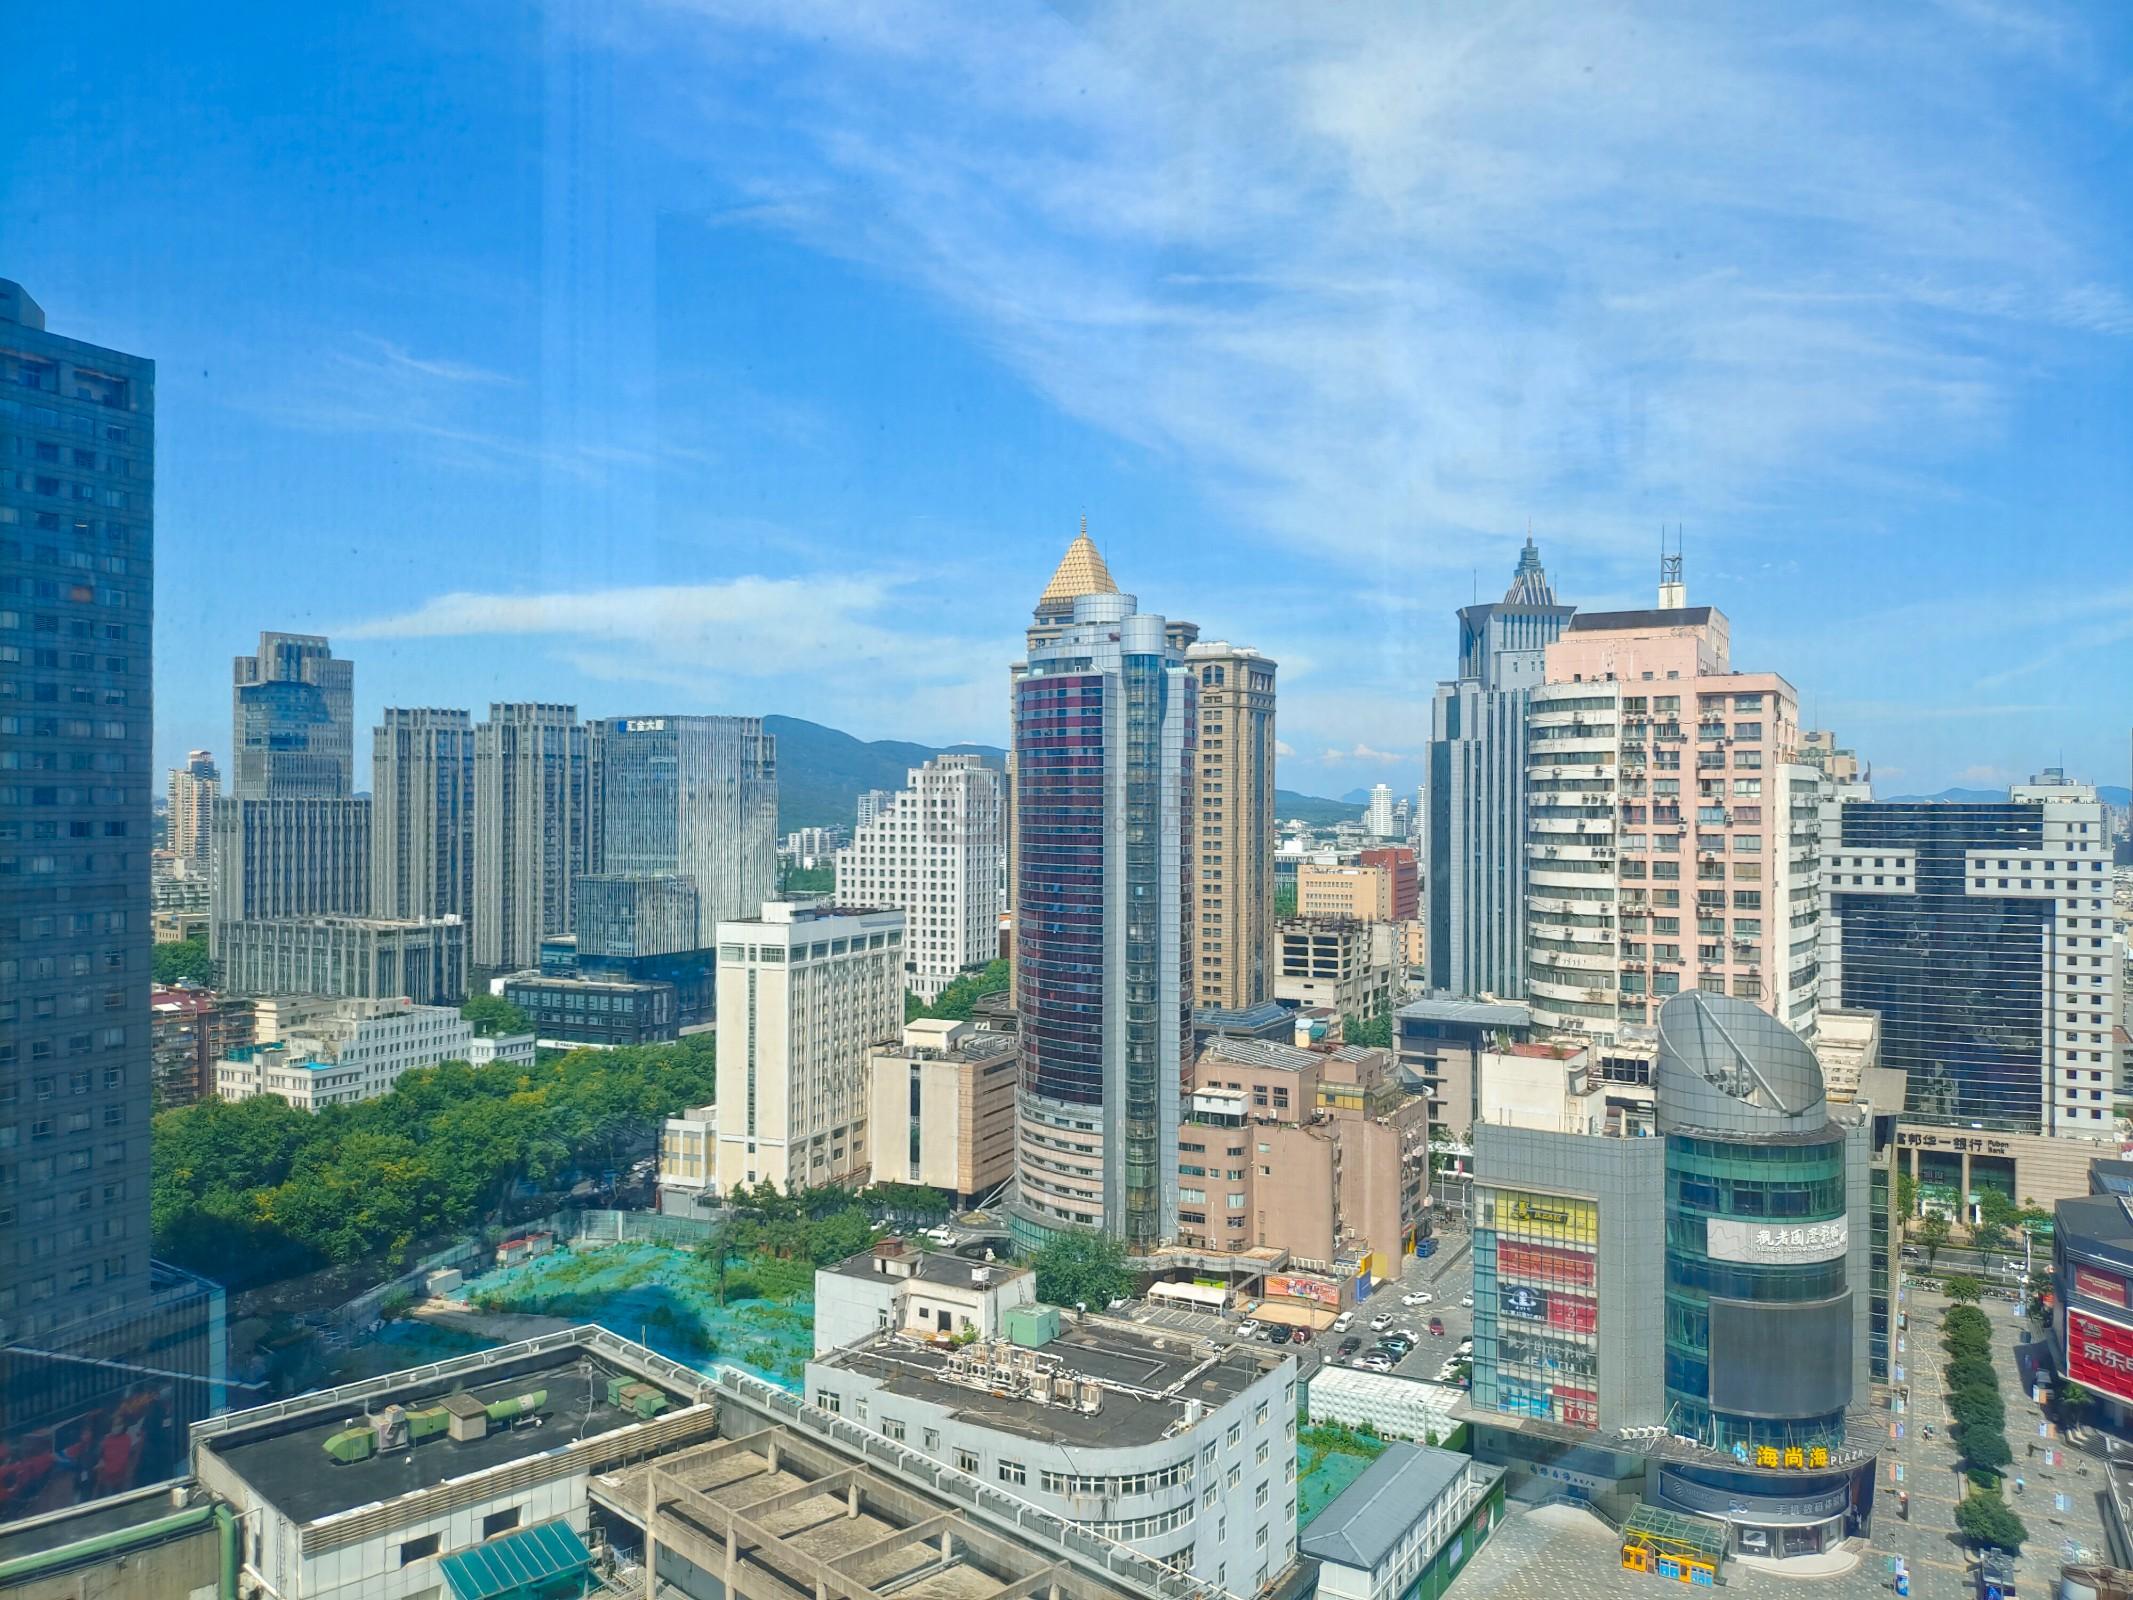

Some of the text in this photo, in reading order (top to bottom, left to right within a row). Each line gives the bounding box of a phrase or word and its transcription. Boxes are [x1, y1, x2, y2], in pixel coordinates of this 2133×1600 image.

[1756, 1446, 1828, 1468] 海尚海
[1830, 1449, 1864, 1465] PLAZA
